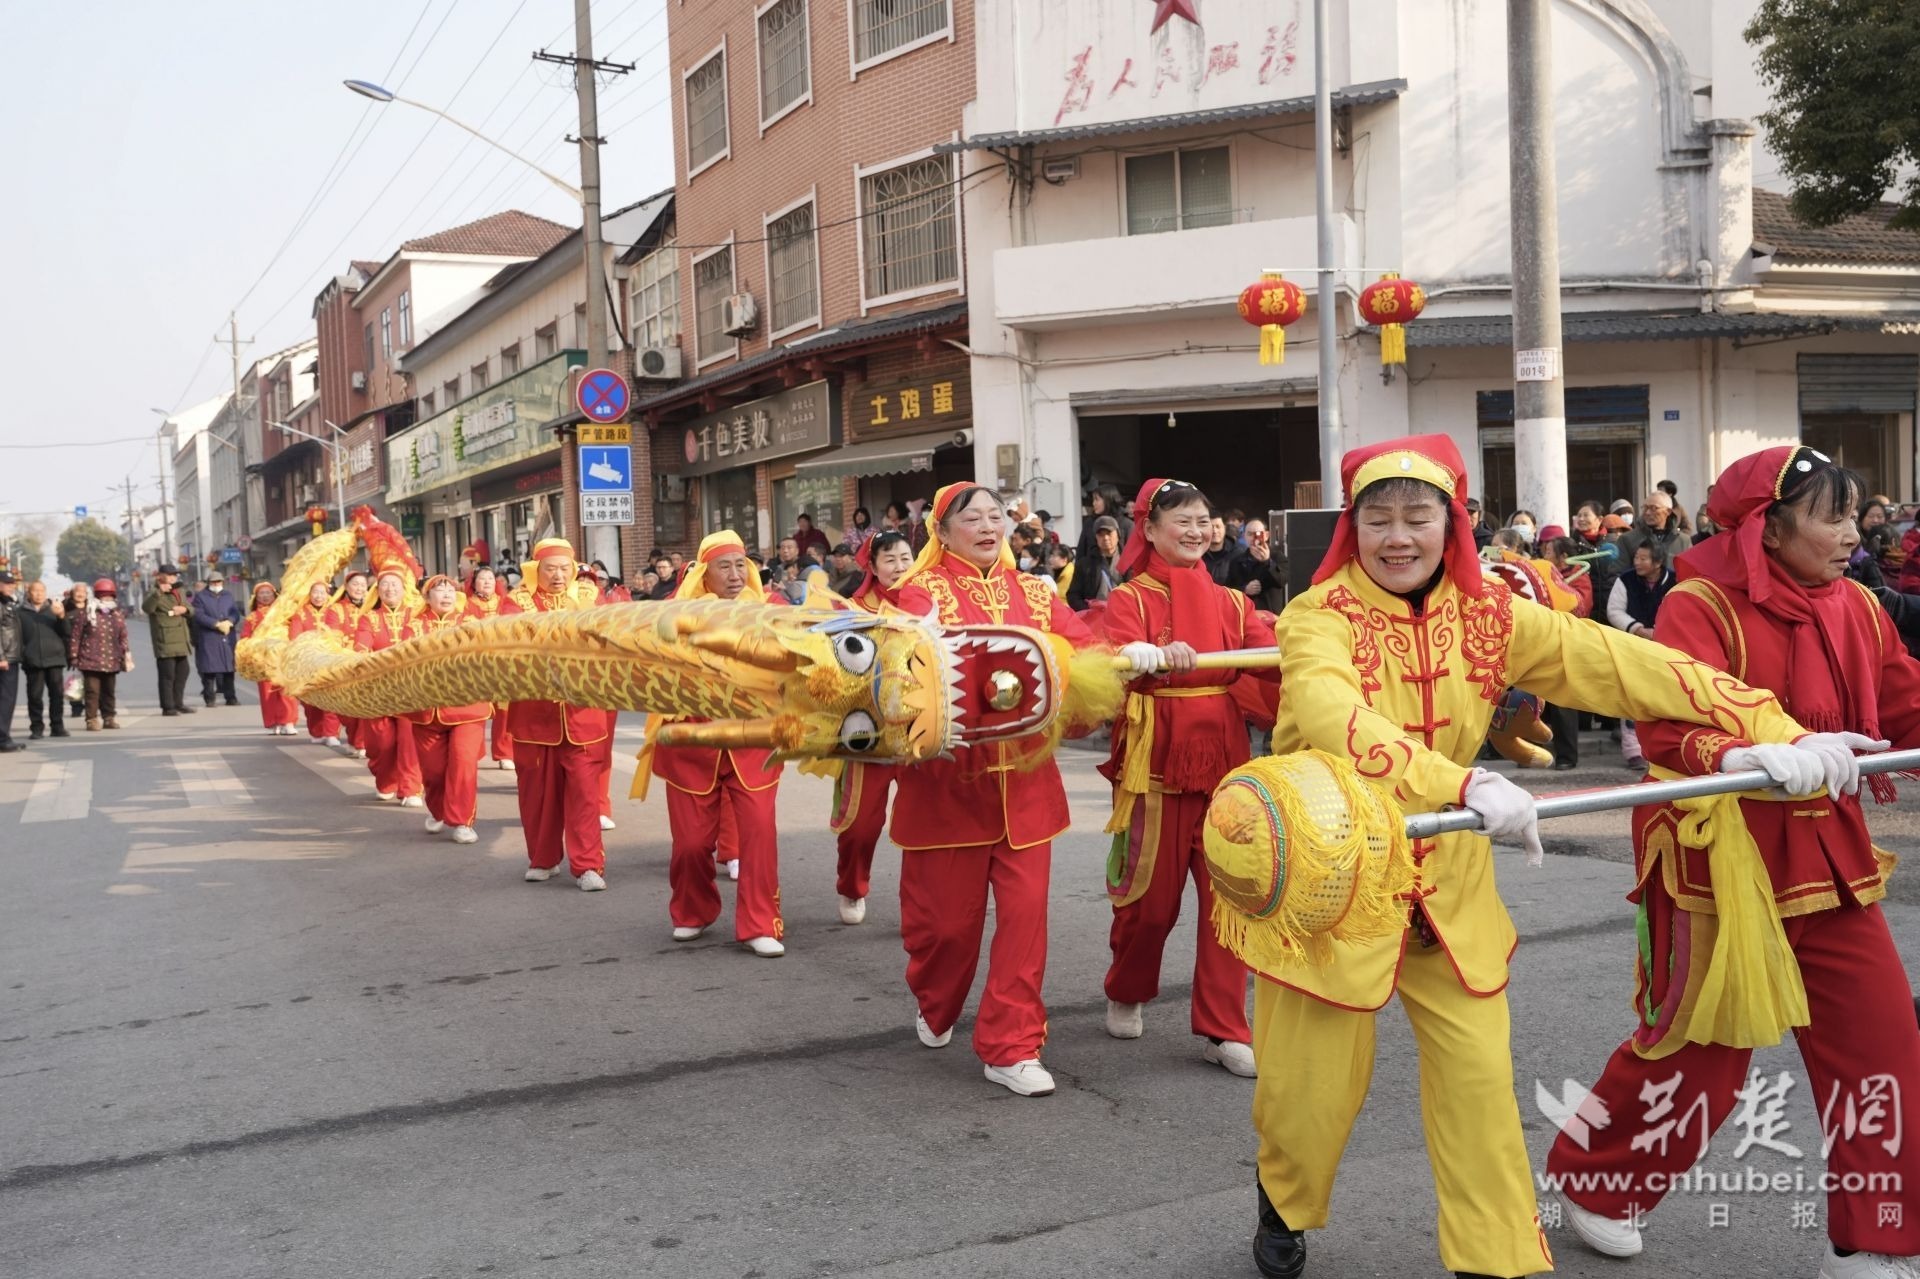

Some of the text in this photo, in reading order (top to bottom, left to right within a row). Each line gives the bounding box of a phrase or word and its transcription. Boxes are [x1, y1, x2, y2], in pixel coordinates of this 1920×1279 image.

[1258, 287, 1289, 315] 福
[1370, 287, 1400, 315] 福
[1520, 365, 1546, 377] 001号
[870, 382, 953, 425] 土鸡蛋
[595, 406, 611, 414] 全段
[582, 428, 627, 440] 严管路段
[698, 410, 771, 461] 千色美妆
[586, 497, 630, 507] 全段禁停
[586, 511, 630, 520] 违停抓拍
